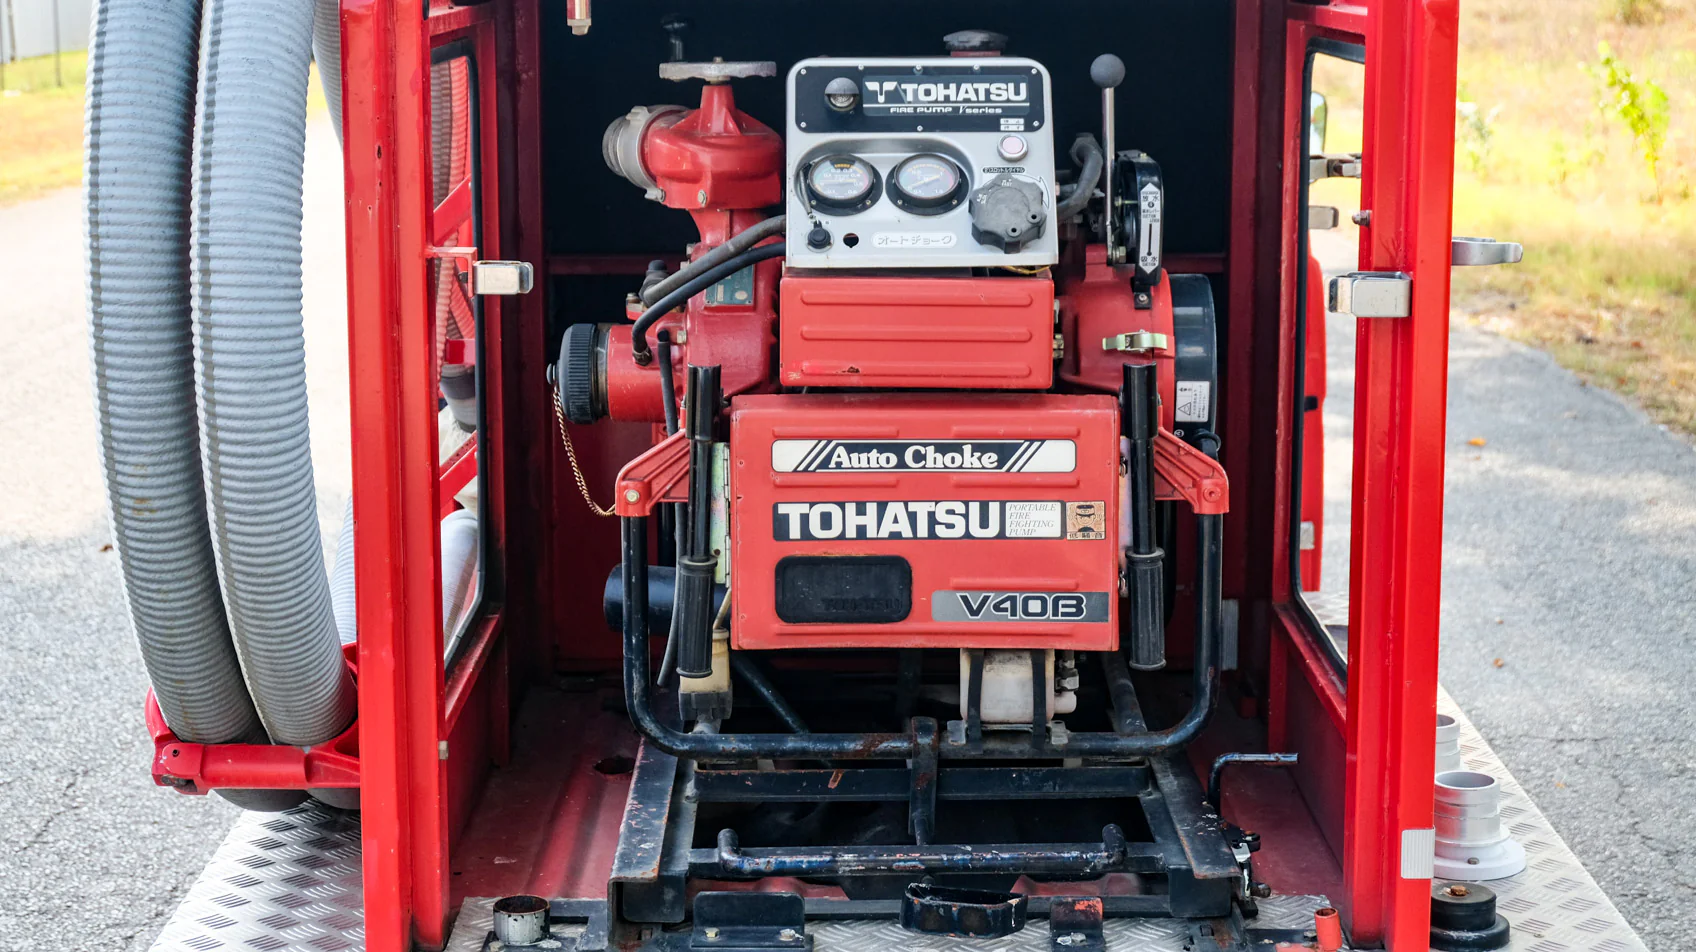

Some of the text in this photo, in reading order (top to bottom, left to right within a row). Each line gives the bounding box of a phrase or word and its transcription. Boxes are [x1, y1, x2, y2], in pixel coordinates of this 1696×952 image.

[901, 82, 1027, 102] TOHATSU
[877, 235, 952, 245] オートチョーク
[828, 444, 998, 469] Auto Choke
[1008, 503, 1057, 512] PORTABLE
[777, 501, 1000, 540] TOHATSU
[1008, 512, 1032, 520] FIRE
[1008, 520, 1055, 528] FIGHTING
[1008, 528, 1037, 536] PUMP
[955, 592, 1087, 620] V40B
